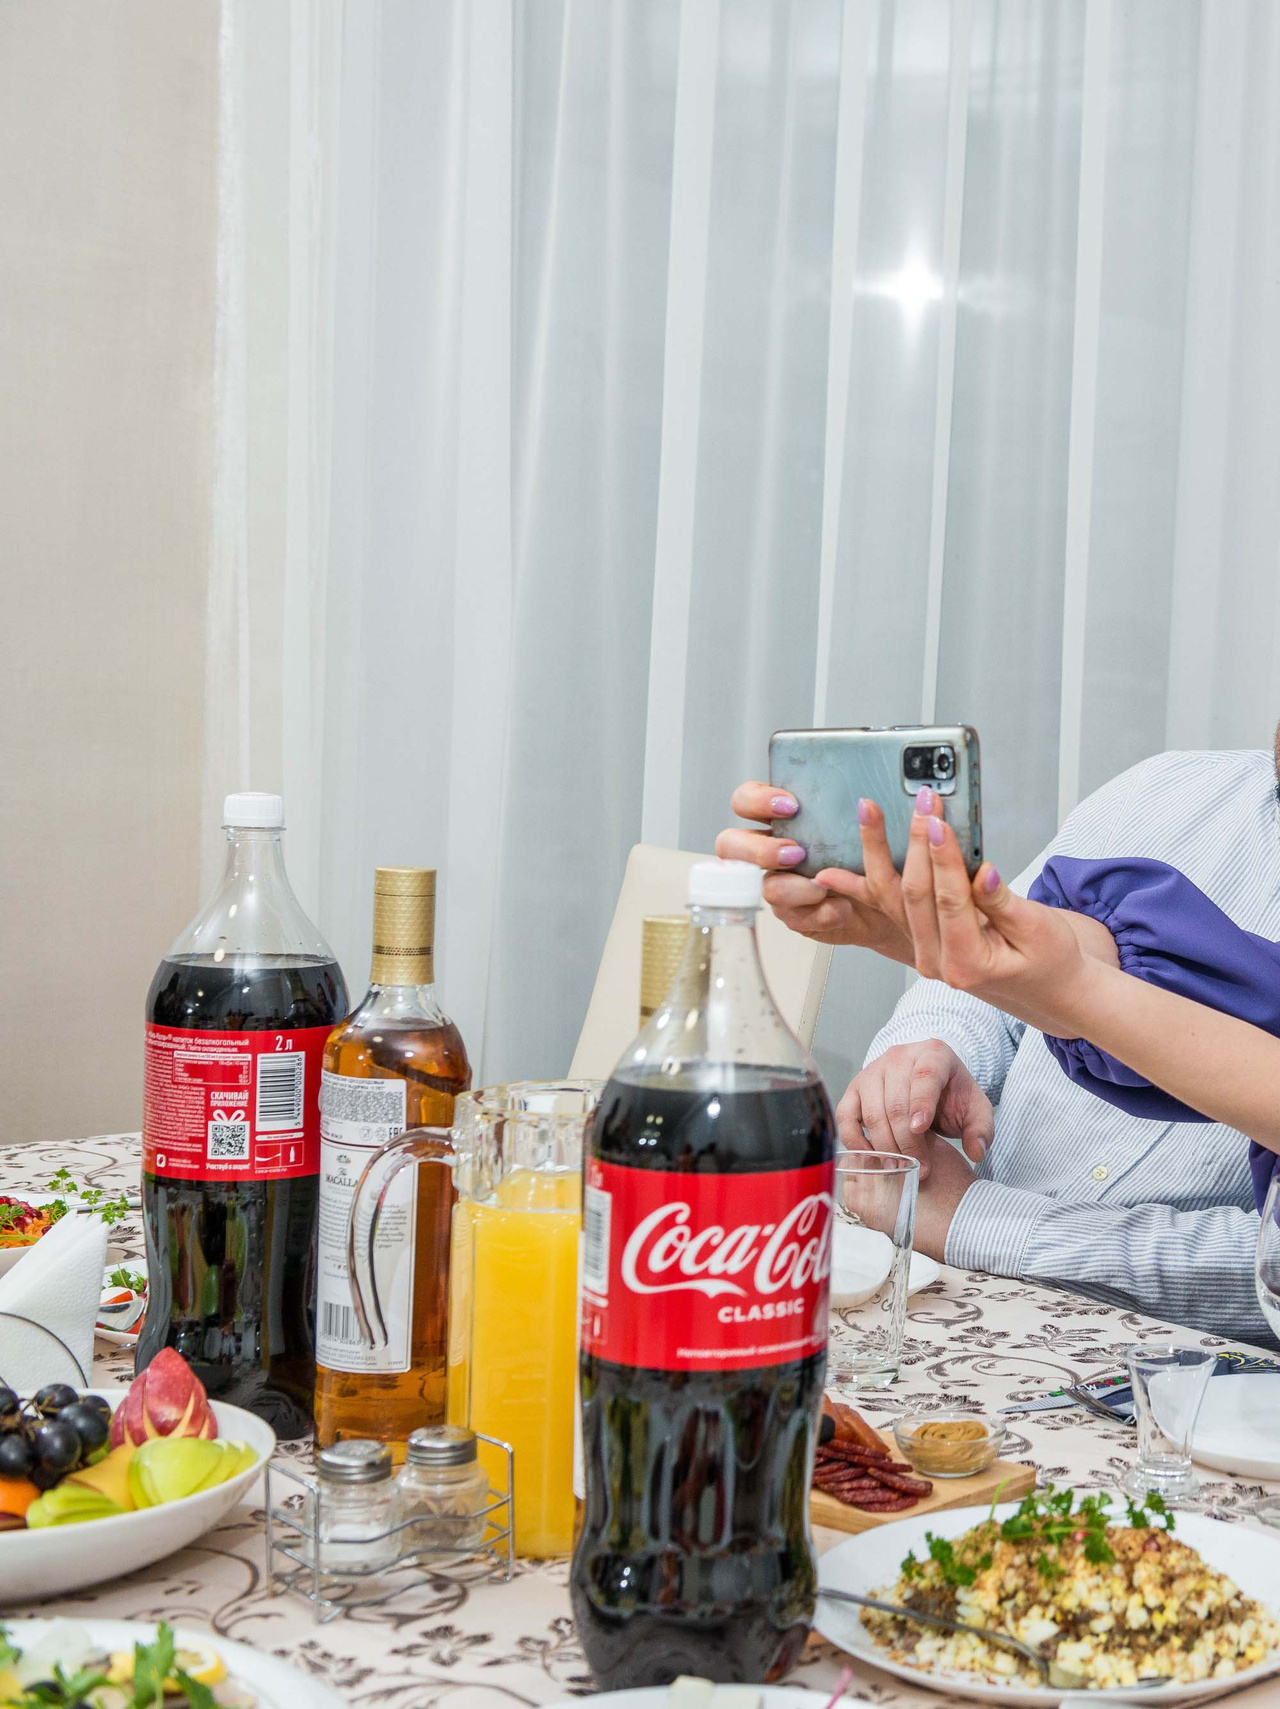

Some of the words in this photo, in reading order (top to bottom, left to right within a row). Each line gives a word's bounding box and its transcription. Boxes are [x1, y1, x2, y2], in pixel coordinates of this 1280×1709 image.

[194, 1036, 250, 1047] безалкогольный
[274, 1035, 283, 1052] 2
[284, 1039, 293, 1051] л
[210, 1090, 250, 1101] СКАЧИВАЙ
[210, 1100, 248, 1108] ПРИЛОЖЕНИЕ
[325, 1173, 359, 1188] MACALLA
[717, 1297, 805, 1324] CLASSIC
